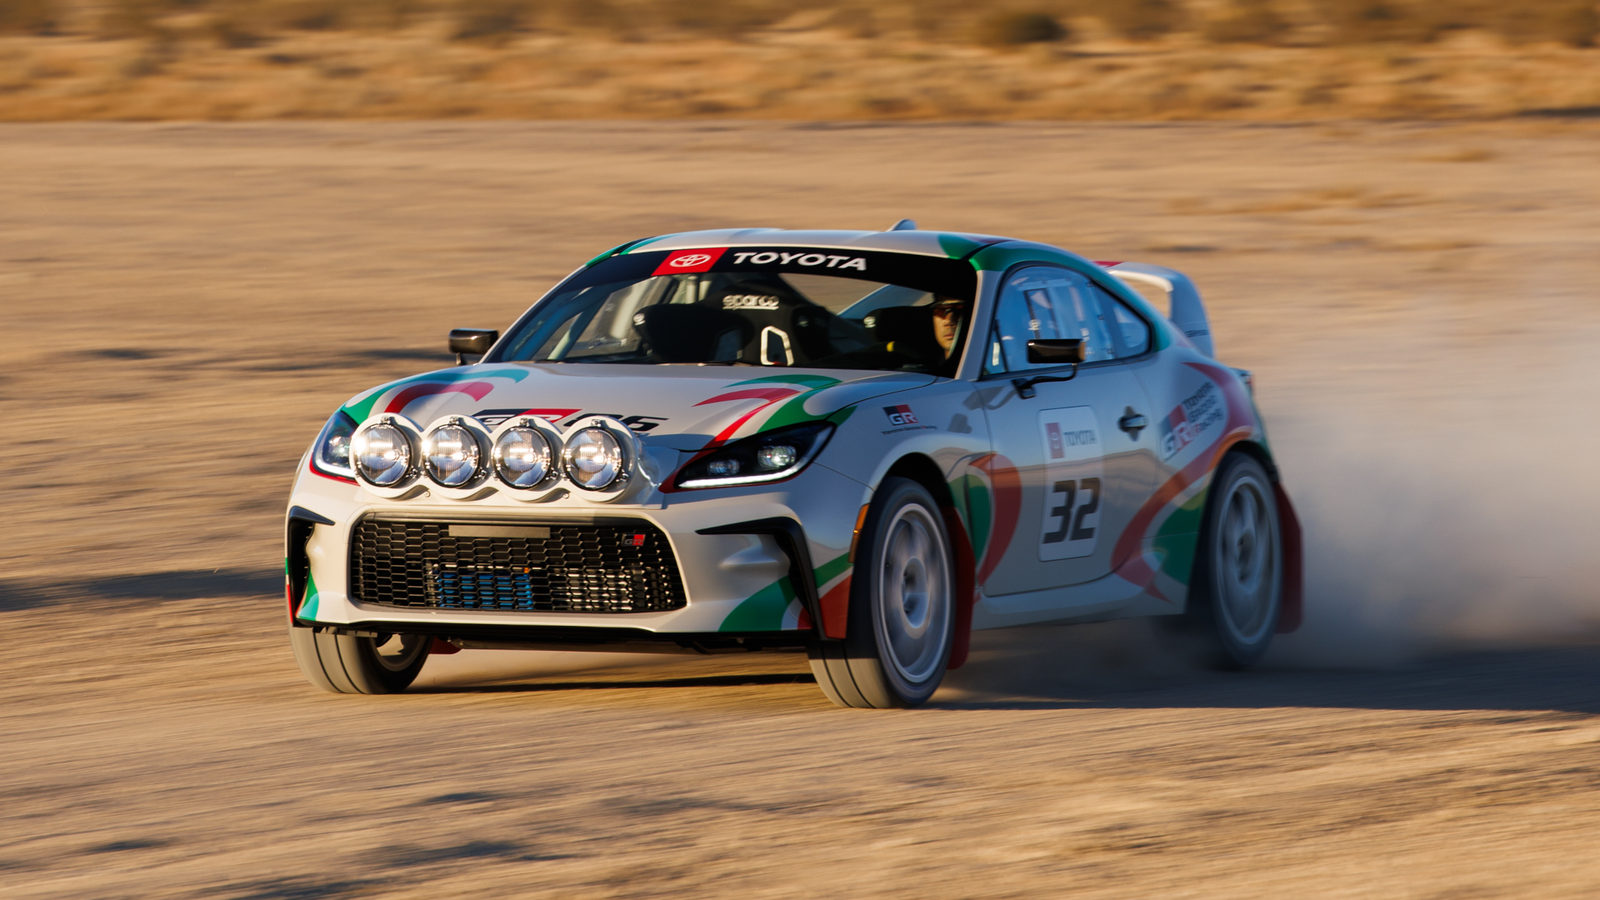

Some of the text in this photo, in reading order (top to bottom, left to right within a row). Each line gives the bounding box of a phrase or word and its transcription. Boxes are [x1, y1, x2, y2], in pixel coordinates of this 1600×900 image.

[733, 252, 867, 271] TOYOTA
[722, 294, 779, 310] sparco
[888, 412, 917, 425] GR
[1063, 429, 1098, 447] TOYOTA
[1161, 421, 1191, 458] GR
[1042, 477, 1101, 545] 32
